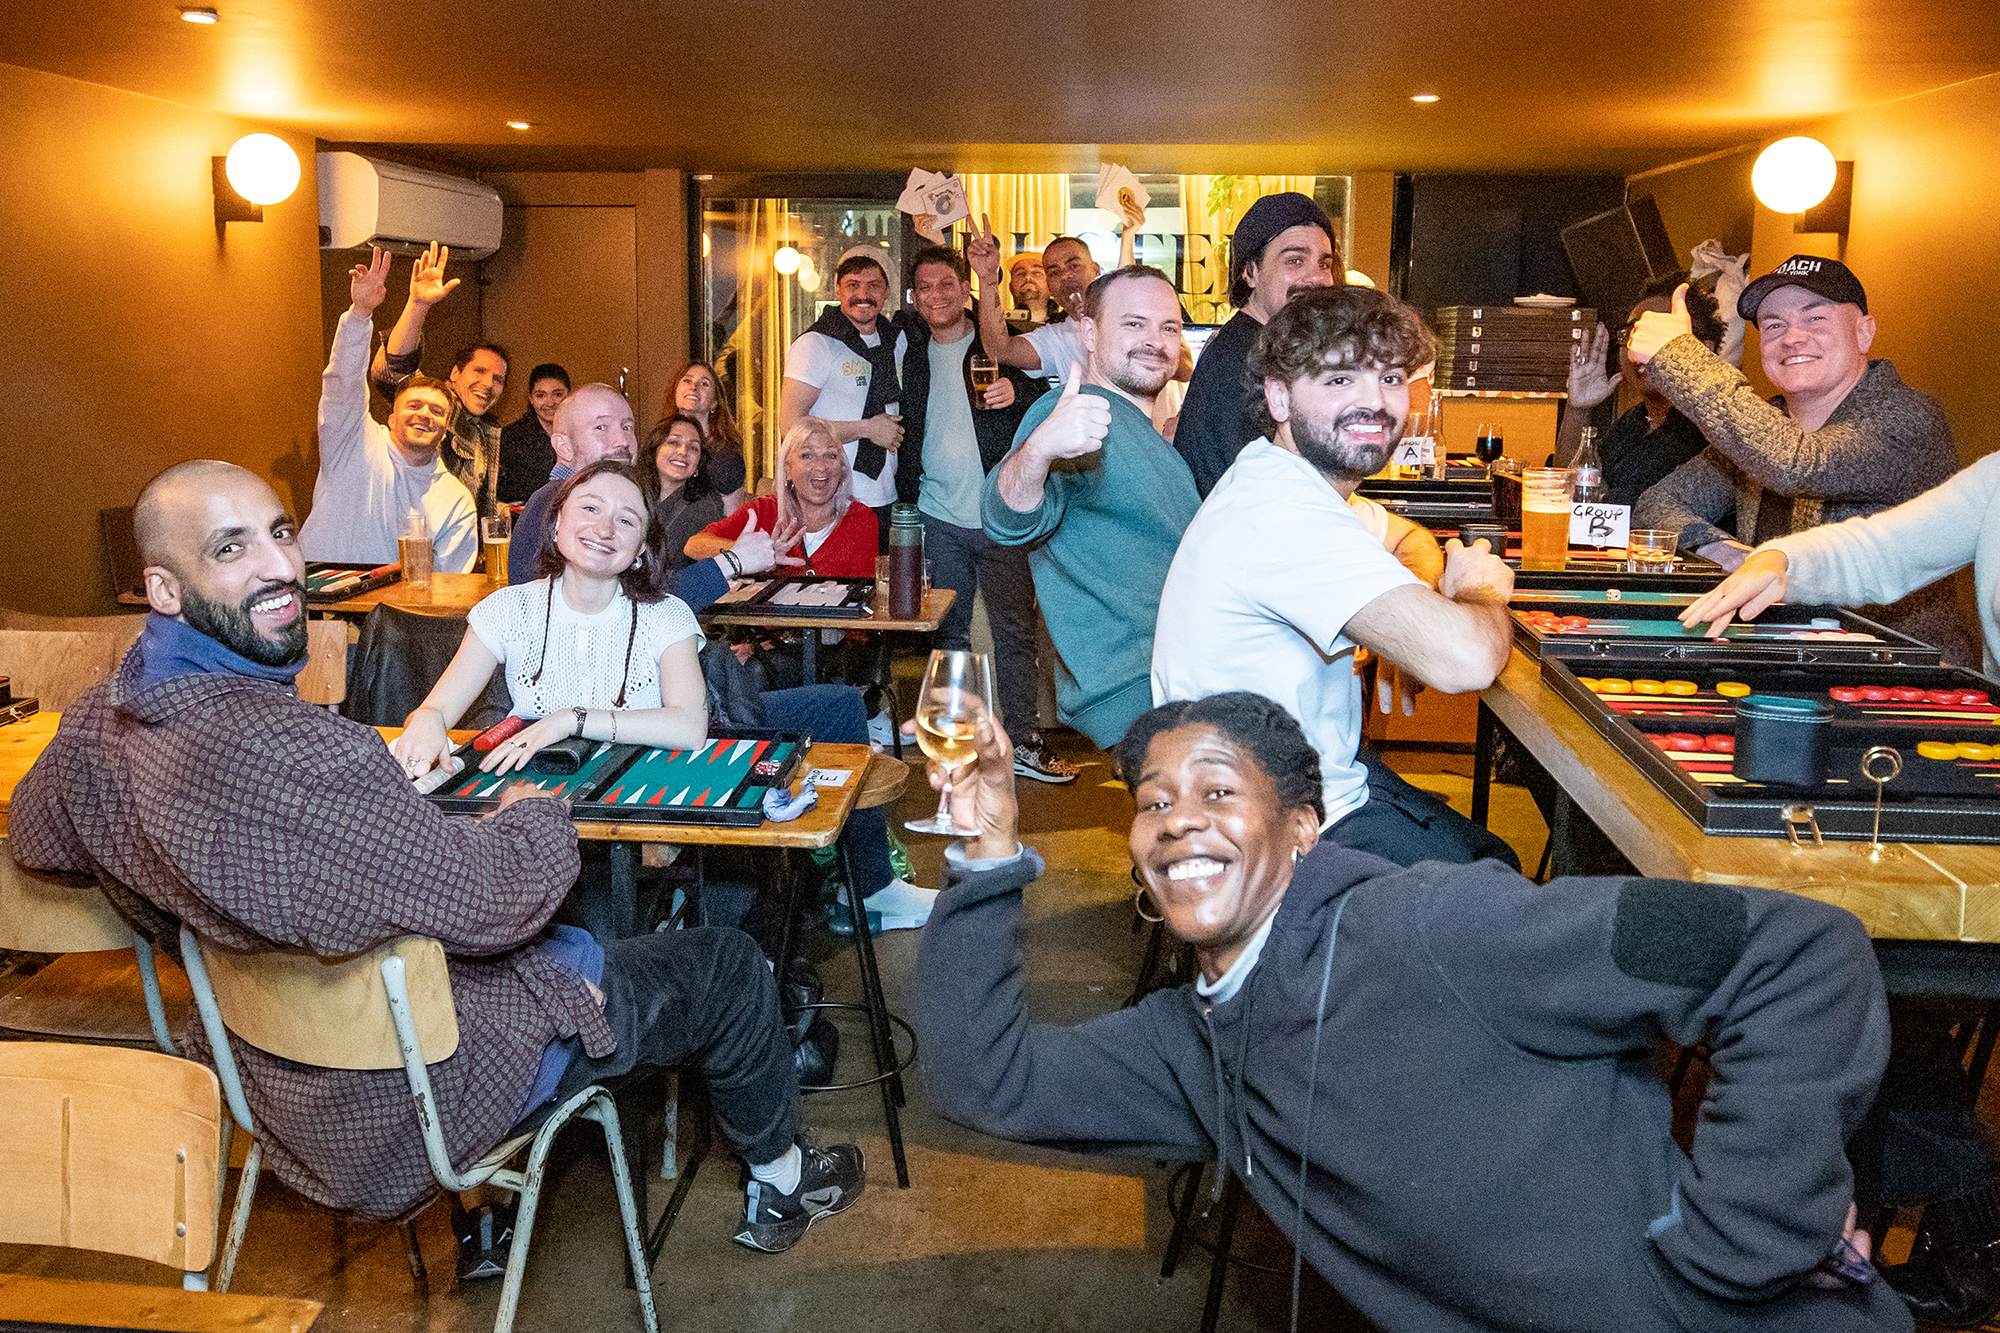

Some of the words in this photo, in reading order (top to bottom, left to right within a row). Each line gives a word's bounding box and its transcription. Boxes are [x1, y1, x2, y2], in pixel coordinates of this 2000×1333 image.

[1775, 260, 1822, 274] OACH
[1403, 446, 1418, 460] A
[1573, 505, 1624, 521] GROUP
[1588, 516, 1614, 538] B
